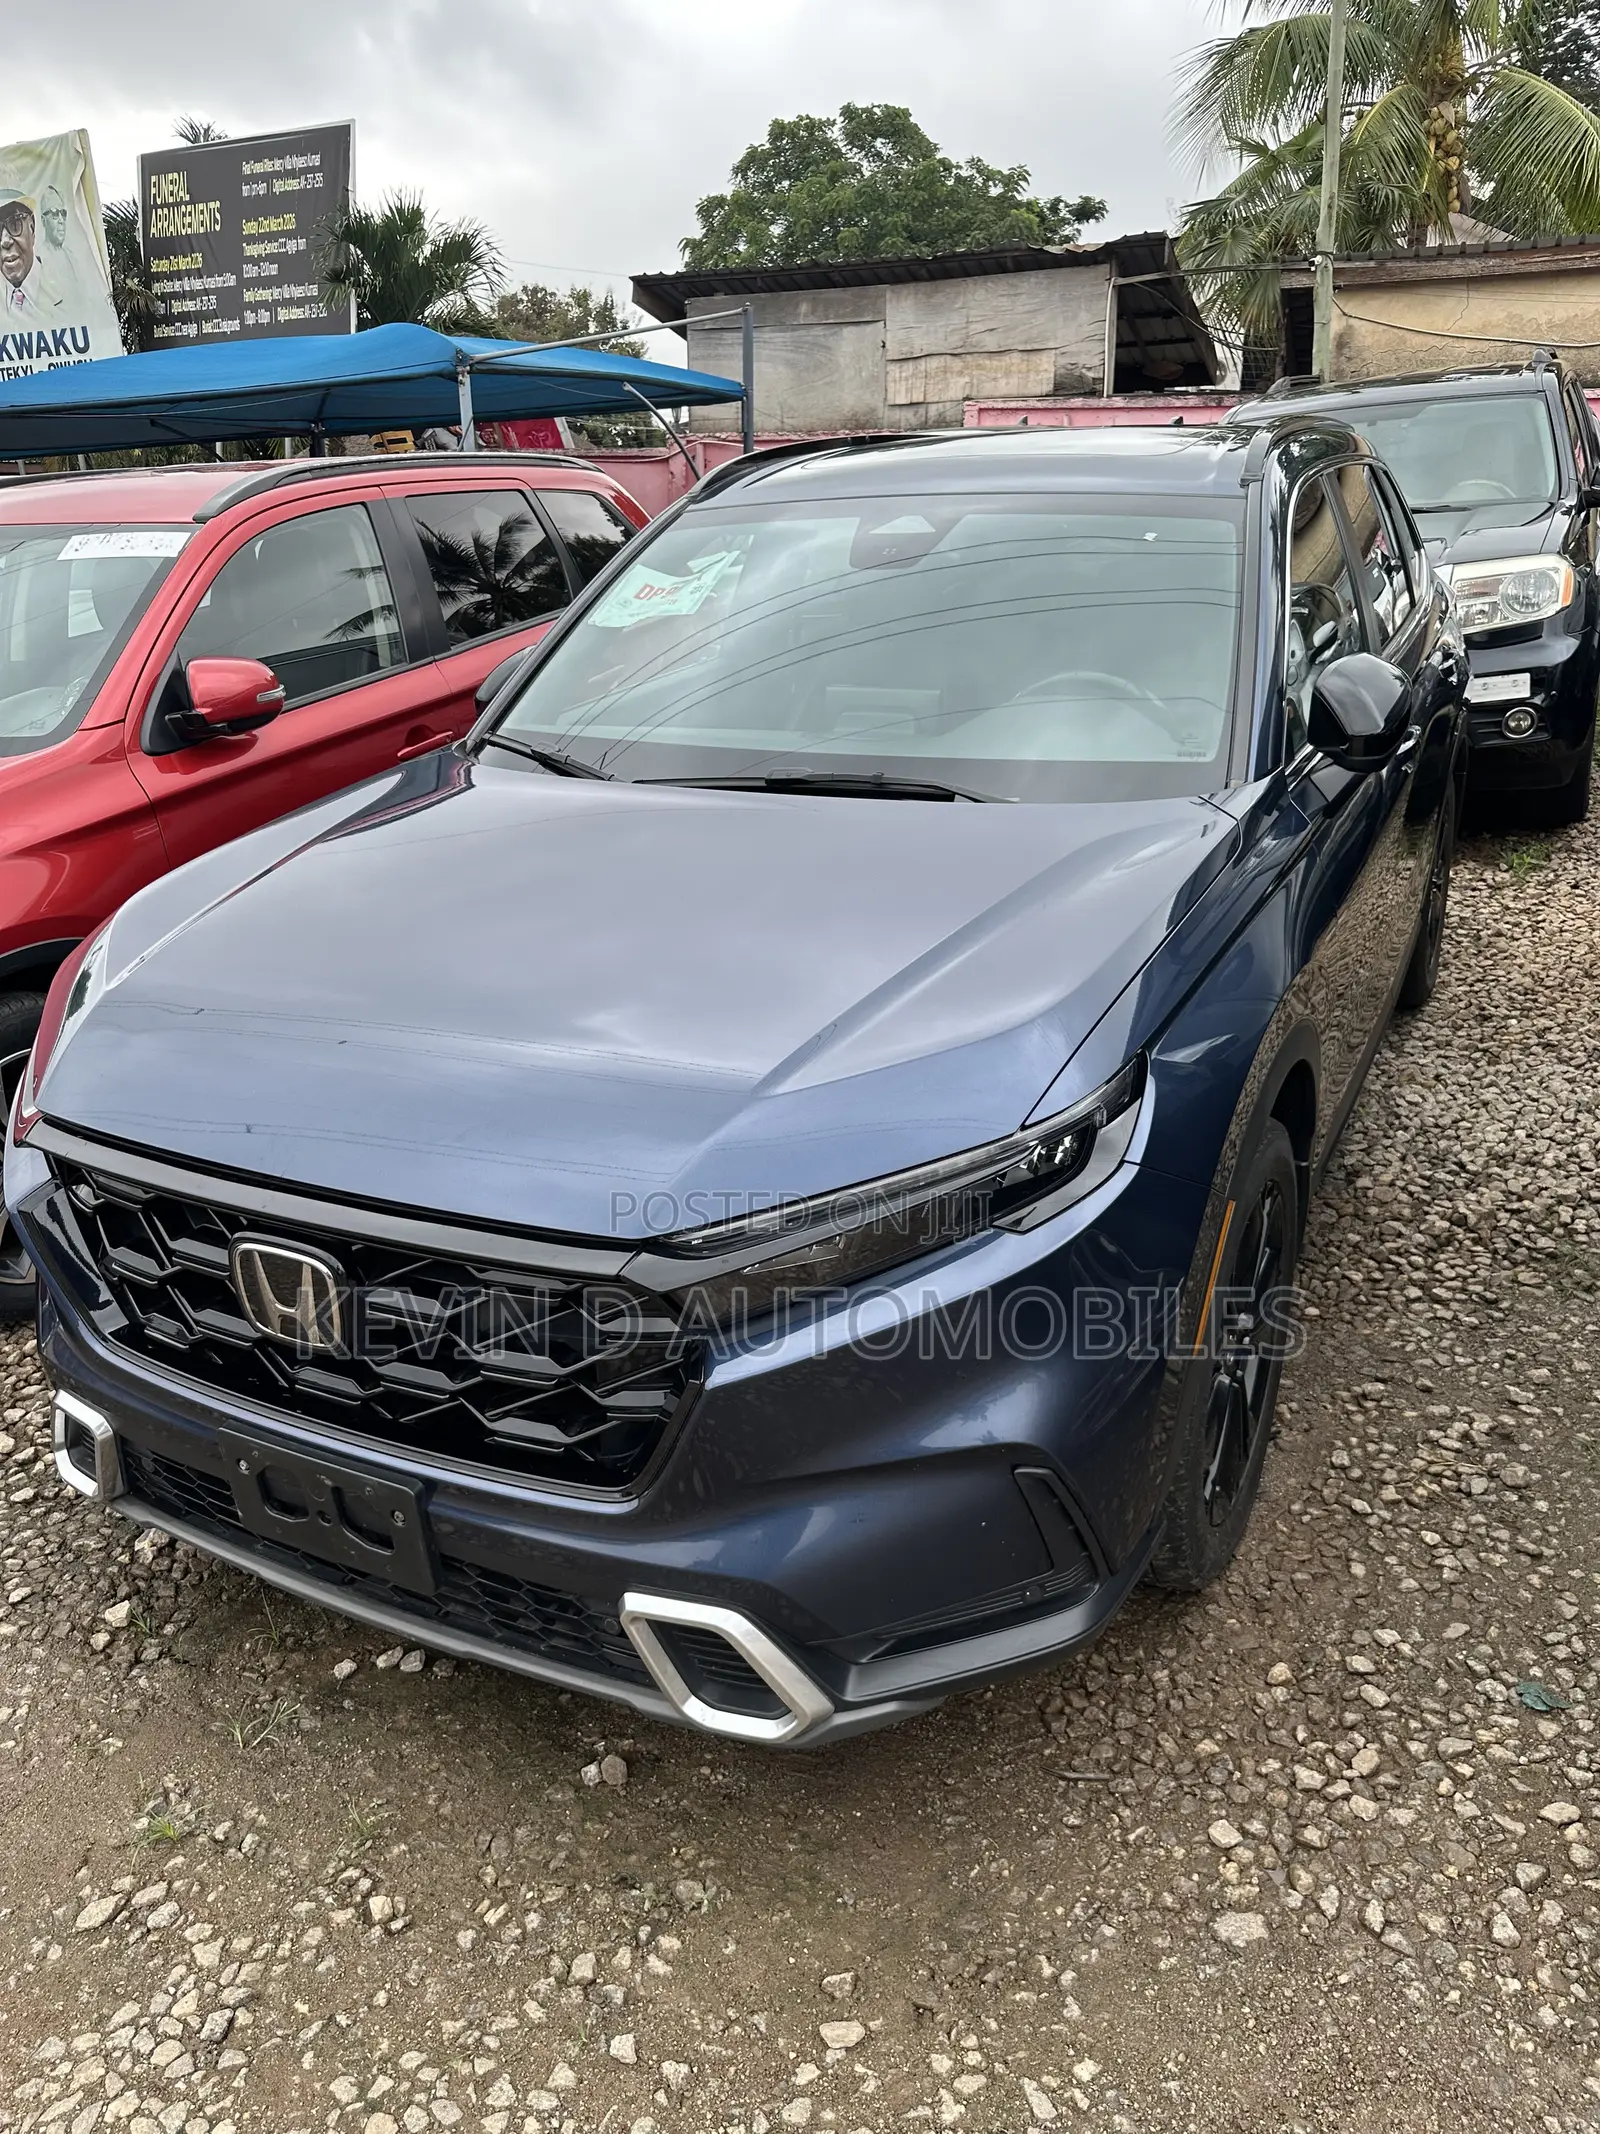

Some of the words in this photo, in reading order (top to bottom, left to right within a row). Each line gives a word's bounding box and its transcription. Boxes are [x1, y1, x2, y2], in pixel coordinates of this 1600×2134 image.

[150, 171, 190, 205] FUNERAL
[150, 200, 220, 238] ARRANGEMENTS
[242, 218, 258, 236] Sunday
[259, 216, 269, 234] 22nd
[270, 214, 283, 232] March
[150, 256, 170, 274] Saturday
[178, 254, 191, 270] March
[0, 326, 90, 362] KWAKU
